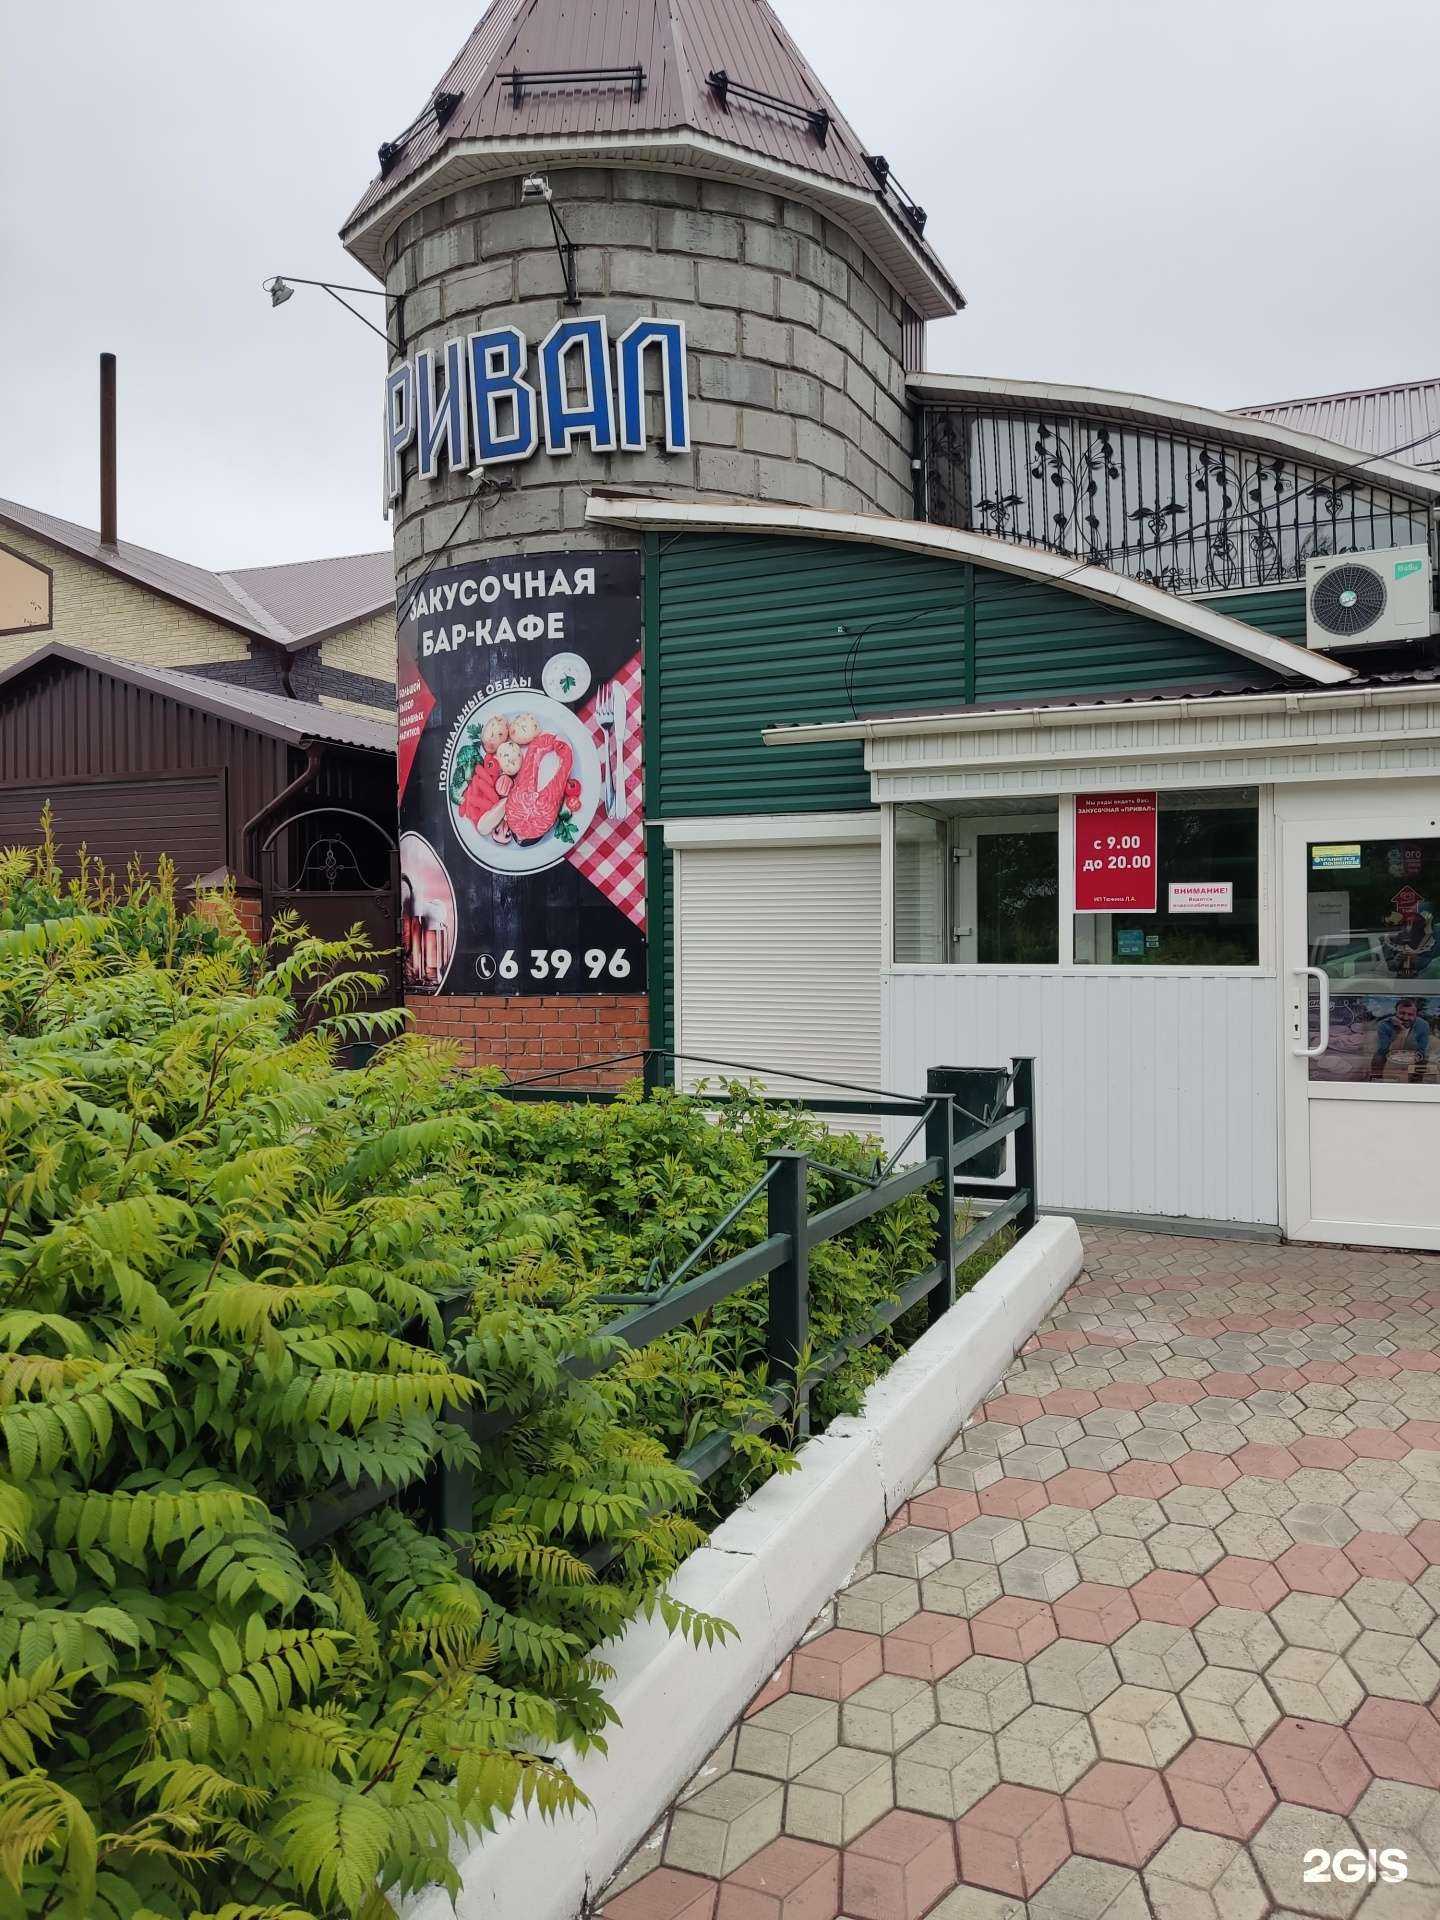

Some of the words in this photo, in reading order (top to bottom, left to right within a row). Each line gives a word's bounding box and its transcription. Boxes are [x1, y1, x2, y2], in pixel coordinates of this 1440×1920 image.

[384, 314, 690, 512] РИВАЛ
[409, 567, 595, 621] ЗАКУСОЧНАЯ
[422, 612, 565, 657] БАР-КАФЕ
[438, 690, 485, 791] ПОМИНАЛЬНЫЕ
[486, 677, 532, 695] ОБЕДЫ
[1077, 806, 1119, 814] ЗАКУСОЧНАЯ
[1093, 840, 1102, 849] с
[1106, 835, 1140, 849] 9.00
[1083, 859, 1103, 872] до
[1107, 855, 1151, 869] 20.00
[1174, 887, 1228, 895] ВНИМАНИЕ!
[499, 949, 519, 979] 6
[530, 949, 573, 979] 39
[584, 949, 631, 979] 96
